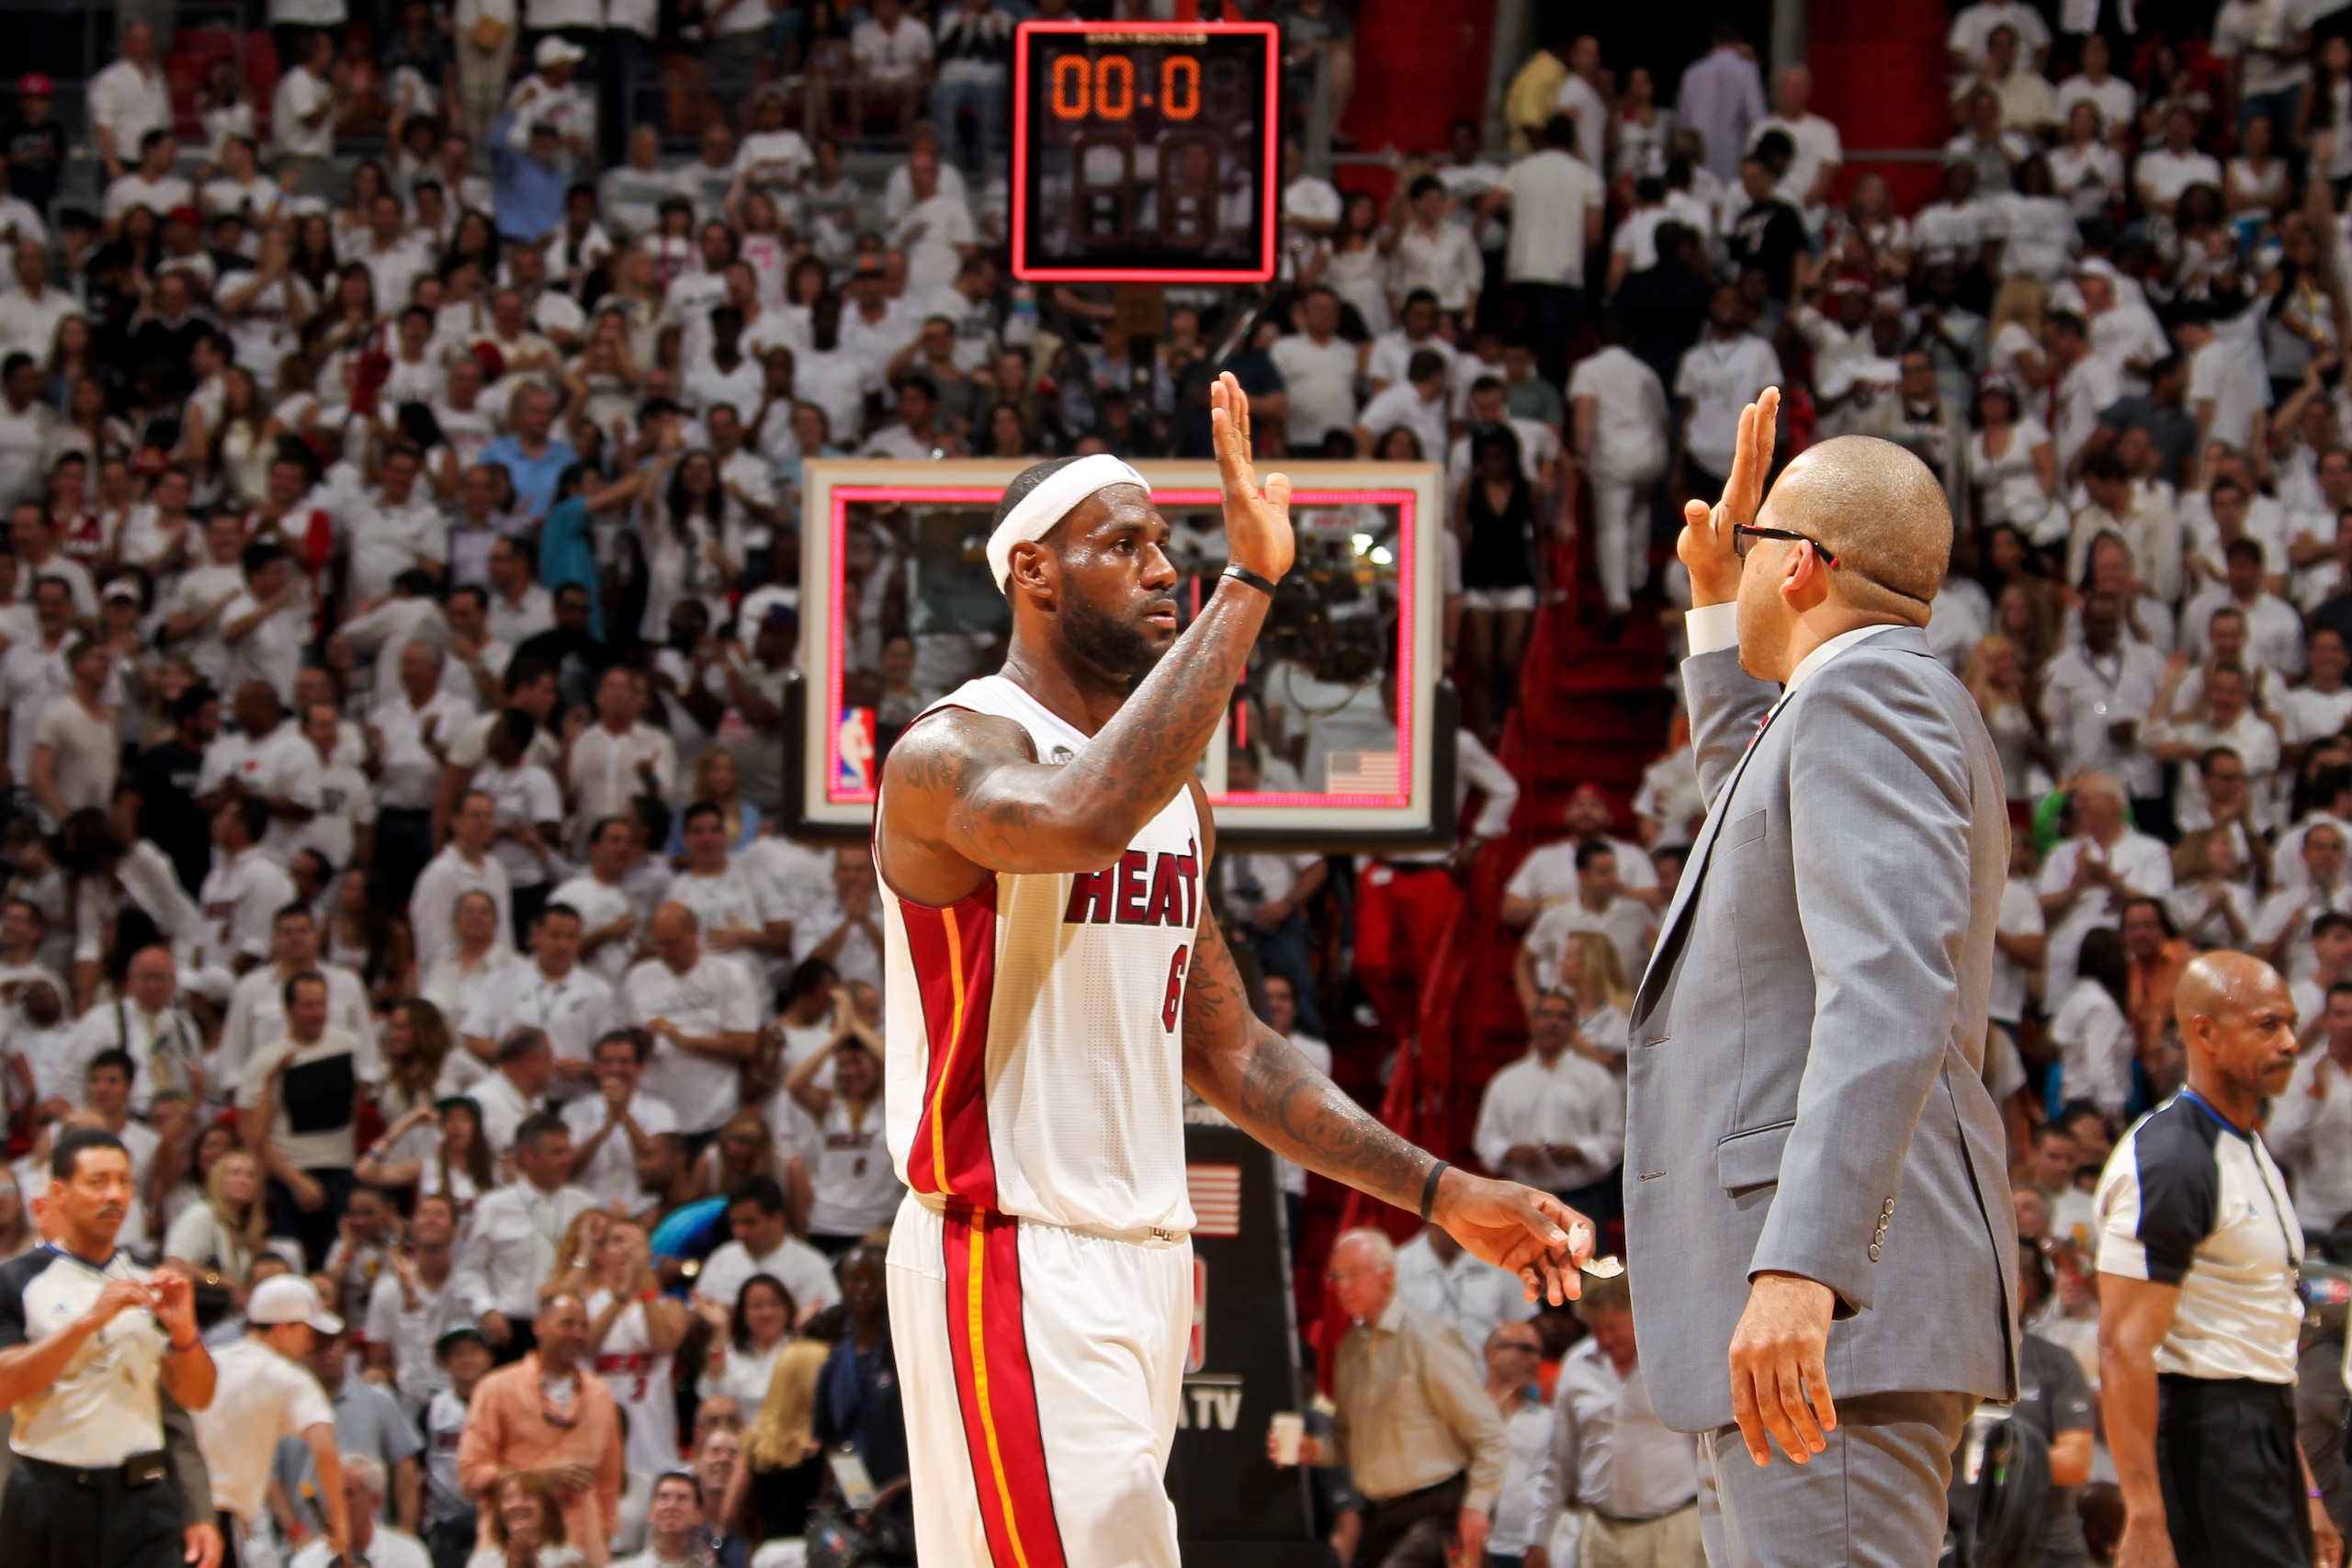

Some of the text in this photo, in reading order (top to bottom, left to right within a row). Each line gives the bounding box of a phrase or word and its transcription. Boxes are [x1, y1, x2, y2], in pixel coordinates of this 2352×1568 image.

[1052, 55, 1200, 120] 00.0
[1063, 837, 1198, 928] HEAT
[1162, 944, 1187, 1033] 6
[1192, 1389, 1241, 1429] TV
